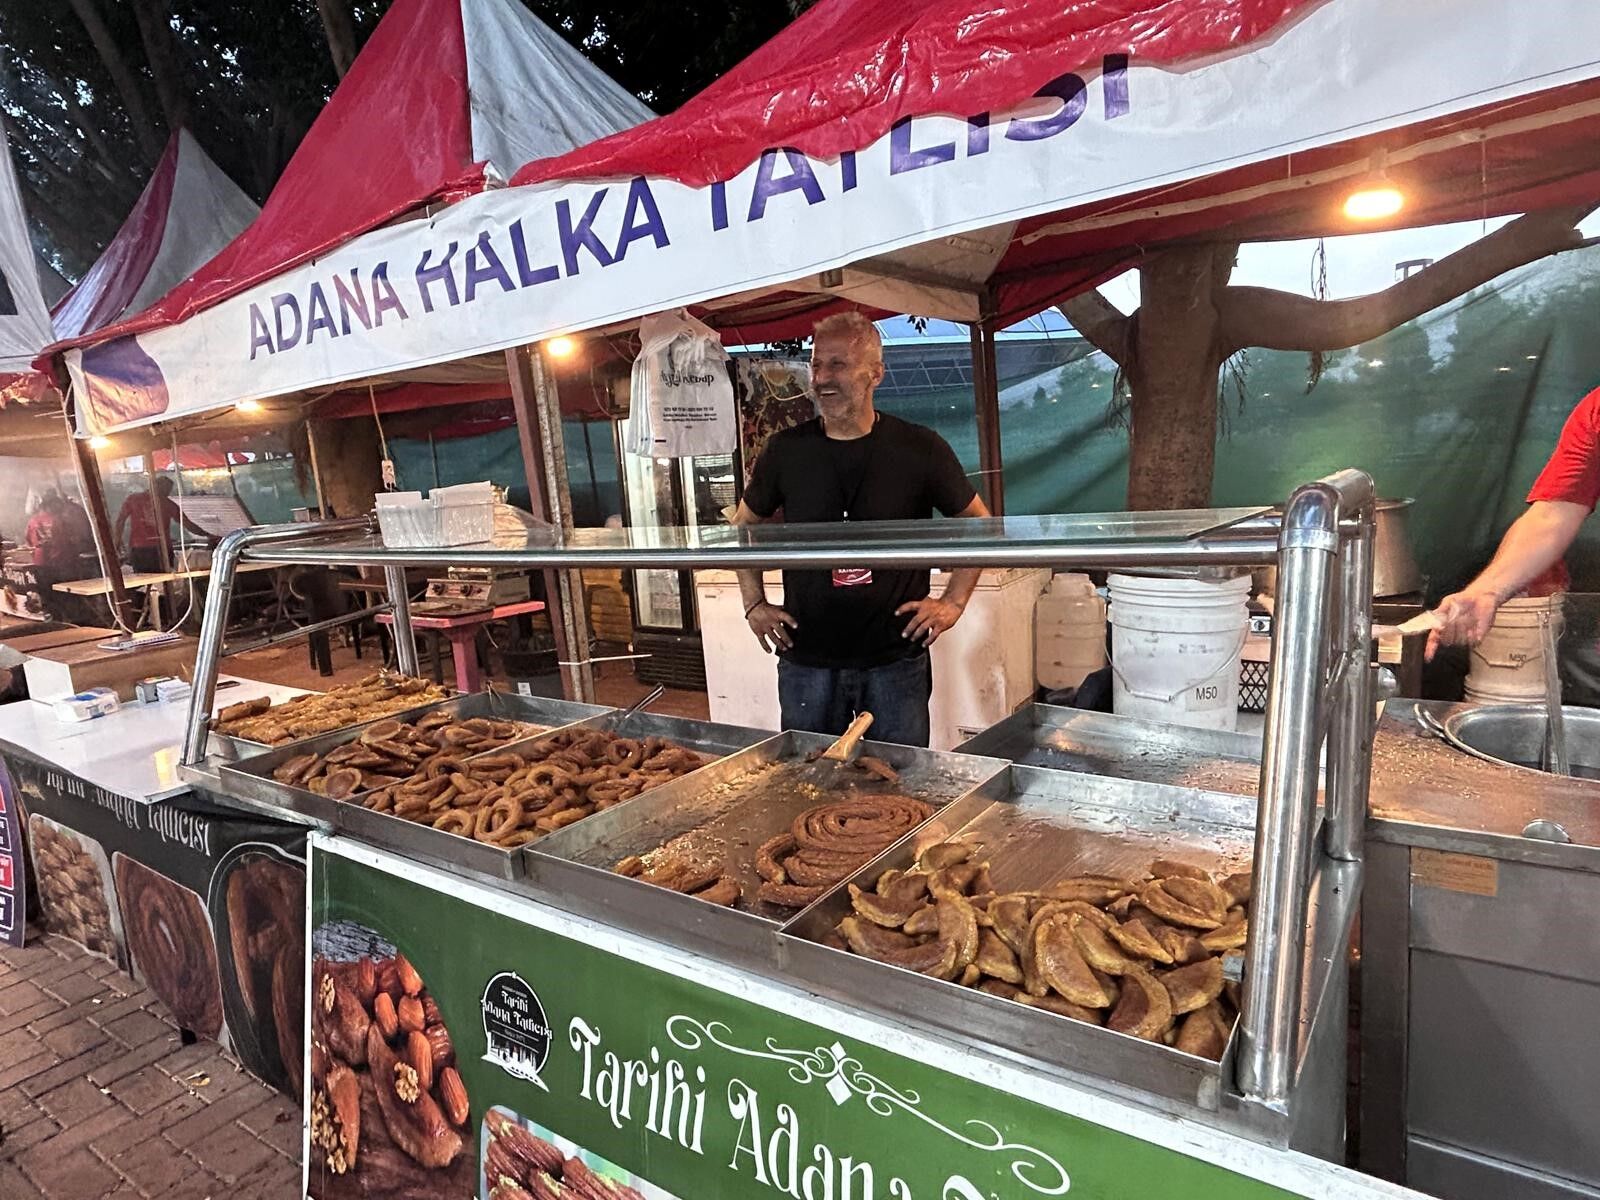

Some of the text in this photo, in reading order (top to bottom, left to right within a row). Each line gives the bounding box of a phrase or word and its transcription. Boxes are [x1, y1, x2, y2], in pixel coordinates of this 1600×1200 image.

[248, 261, 409, 361] ADANA
[417, 175, 671, 313] HALKA
[1196, 686, 1218, 700] M50
[569, 1016, 913, 1200] Tarihi Adan
